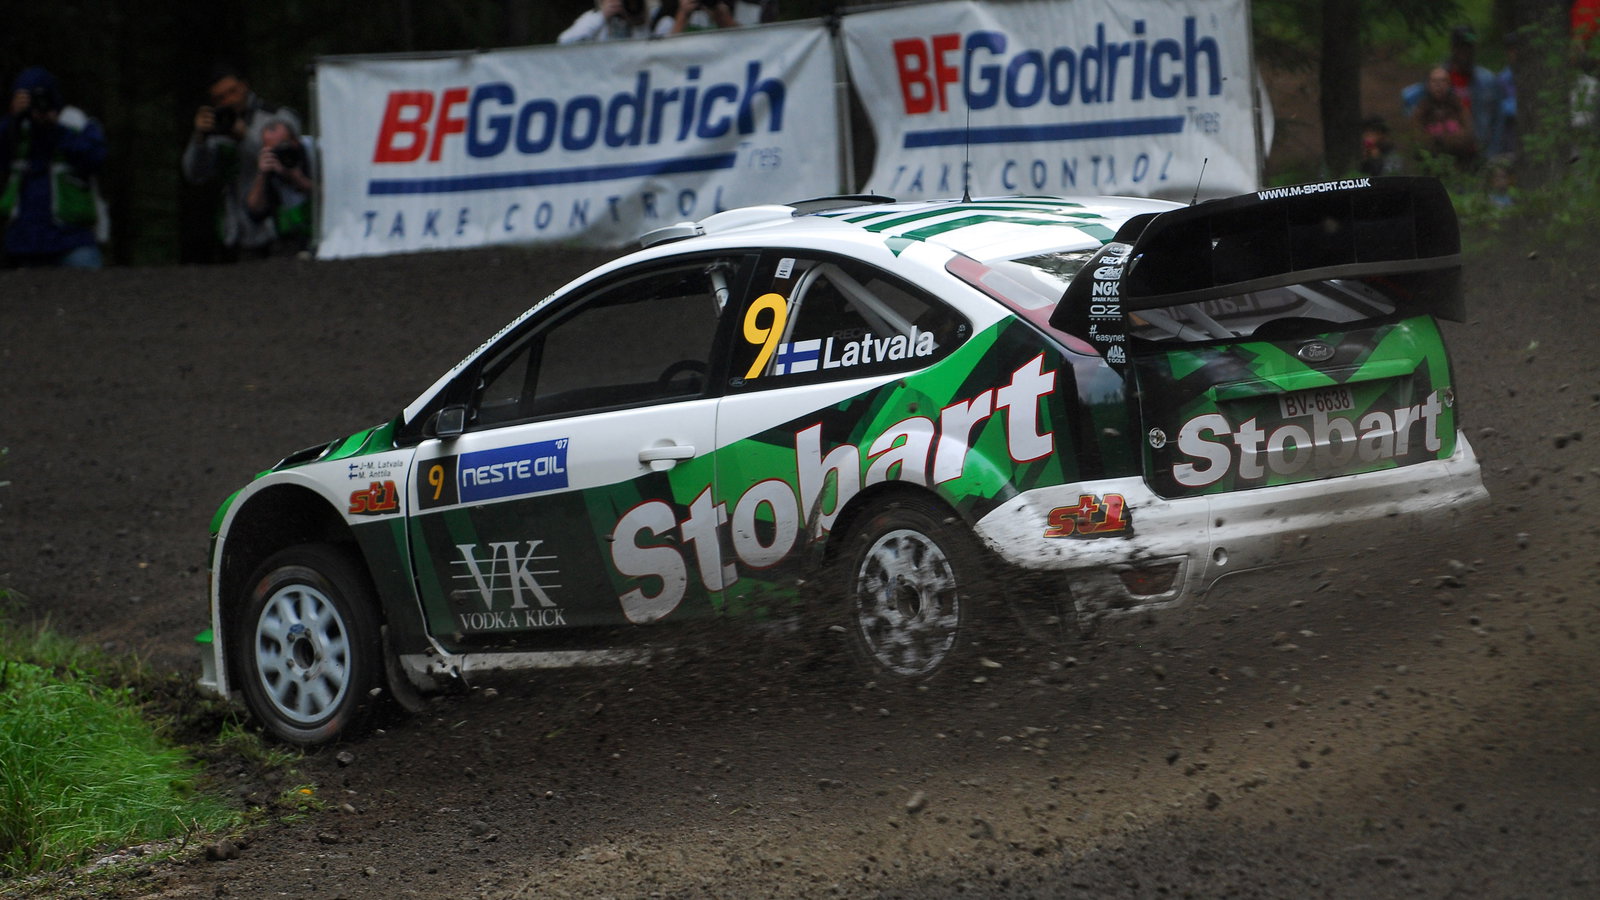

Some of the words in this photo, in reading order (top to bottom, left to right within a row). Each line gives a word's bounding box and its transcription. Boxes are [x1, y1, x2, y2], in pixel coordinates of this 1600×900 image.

[892, 17, 1222, 116] BFGoodrich
[372, 60, 787, 163] BFGoodrich
[1187, 105, 1220, 134] Tres
[740, 141, 783, 170] Tres
[889, 160, 973, 193] TAKE
[1258, 178, 1371, 200] WWW.M-SPORT.CO.UK
[362, 206, 471, 239] TAKE
[502, 185, 726, 233] CONTROL
[1092, 281, 1120, 296] NGK
[743, 292, 788, 379] 9
[823, 325, 935, 370] Latvala
[1095, 334, 1126, 343] easynet
[1309, 345, 1328, 358] Ford
[1285, 389, 1351, 417] BV-6638
[1173, 389, 1444, 488] Stobart
[428, 464, 445, 501] 9
[462, 460, 532, 488] NESTE
[534, 455, 565, 476] OIL
[609, 352, 1057, 626] Stobart
[456, 540, 557, 610] VK
[460, 611, 519, 631] VODKA
[525, 608, 567, 627] KICK
